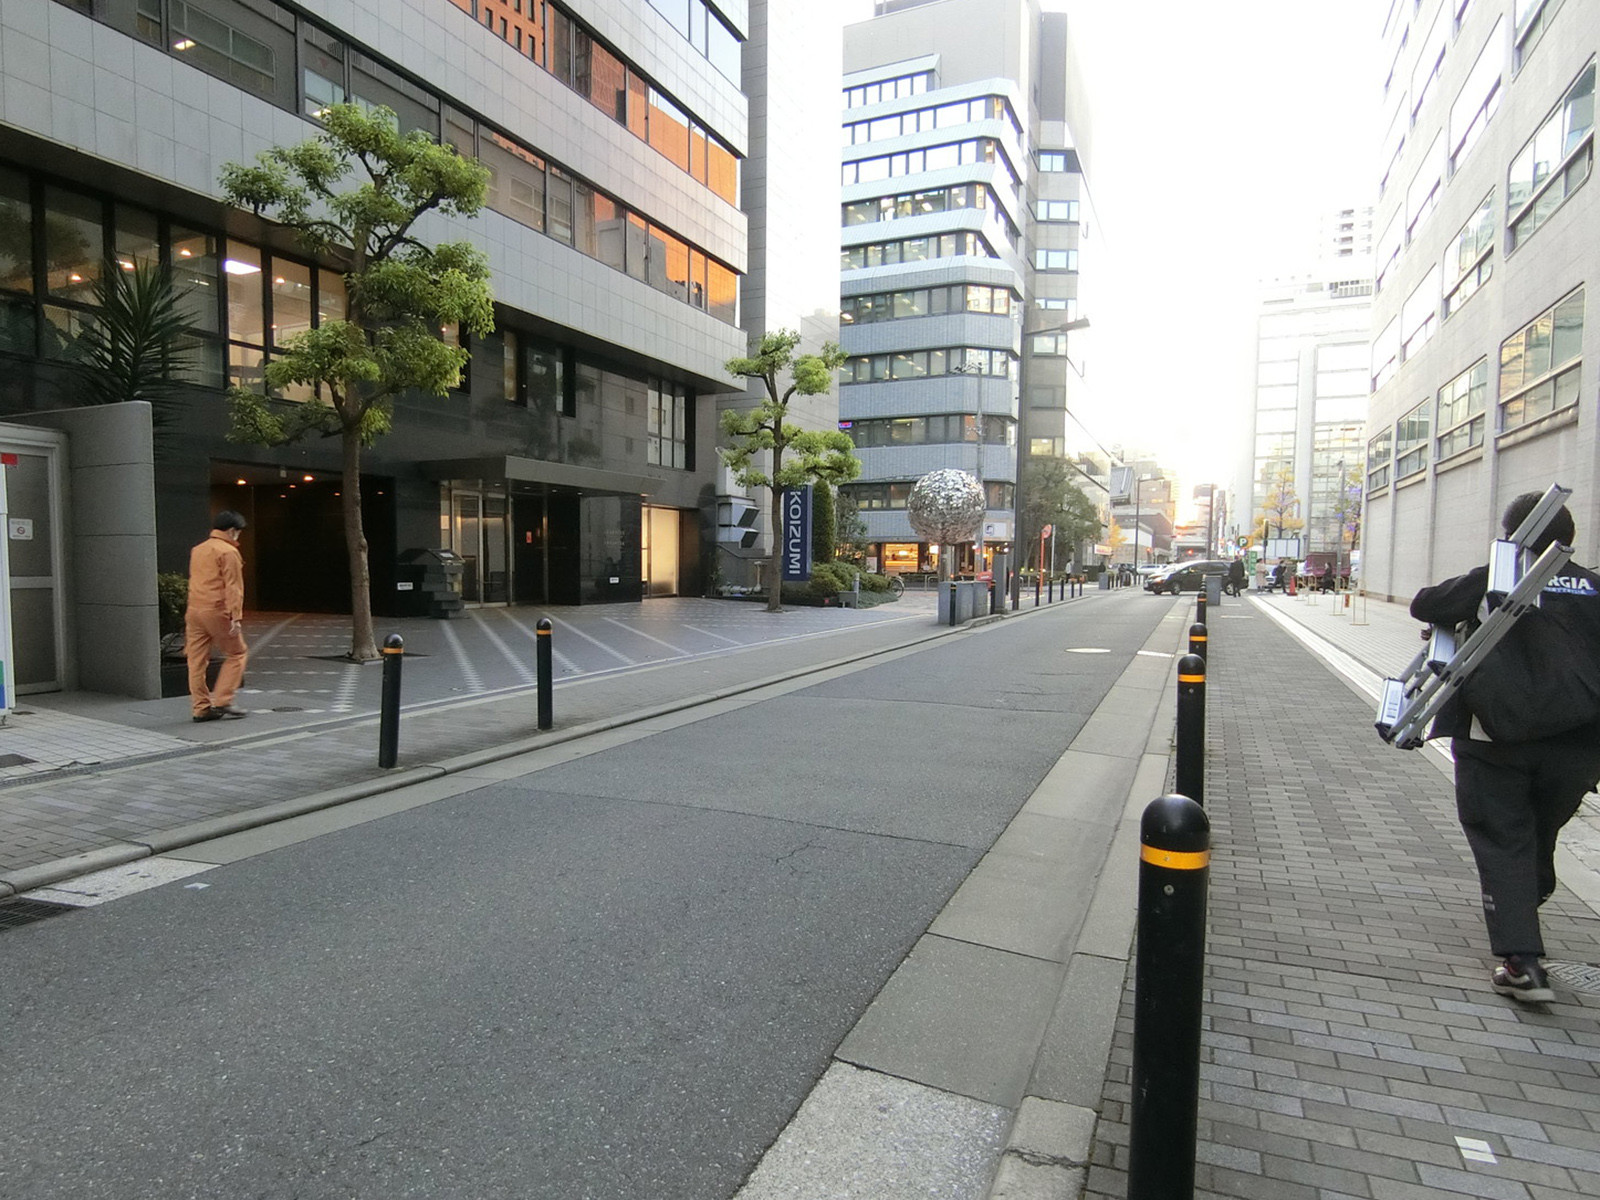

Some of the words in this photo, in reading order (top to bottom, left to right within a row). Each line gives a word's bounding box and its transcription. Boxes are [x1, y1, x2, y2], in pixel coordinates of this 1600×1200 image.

[789, 491, 801, 574] KOIZUMI
[1240, 538, 1247, 546] P
[1547, 575, 1591, 590] RGIA
